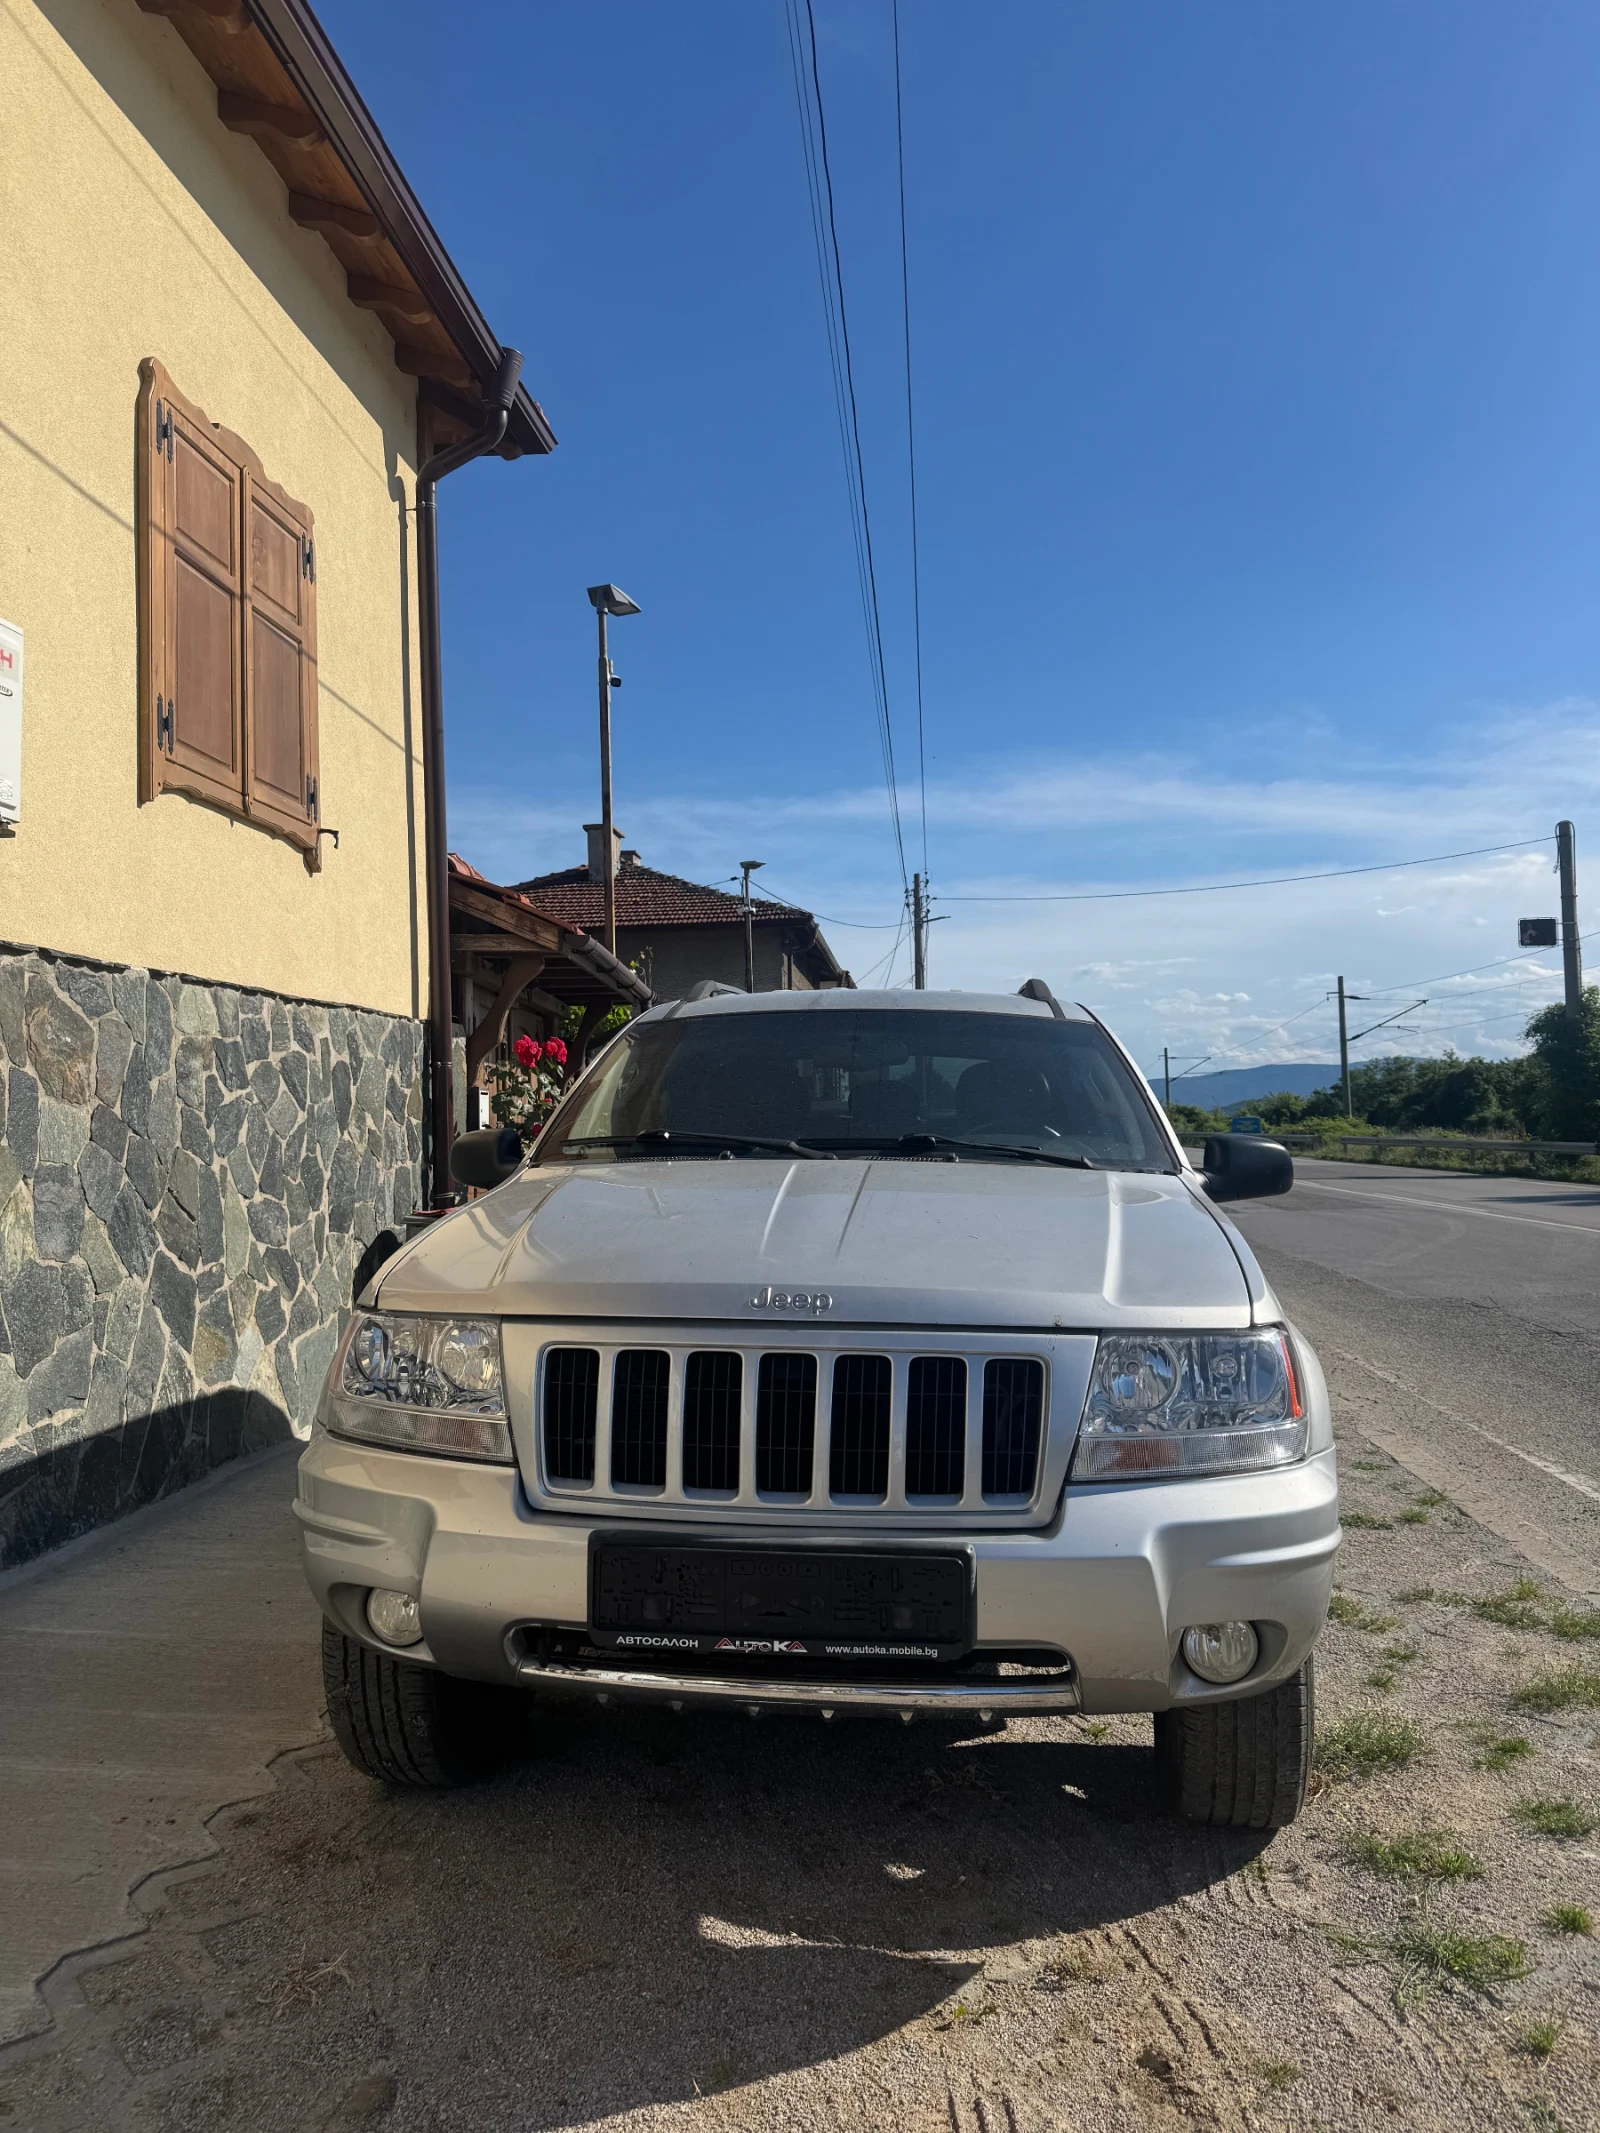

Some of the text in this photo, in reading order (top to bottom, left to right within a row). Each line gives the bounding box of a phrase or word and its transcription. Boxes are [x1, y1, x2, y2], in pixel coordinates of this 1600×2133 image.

[749, 1286, 833, 1316] Jeep
[616, 1635, 699, 1649] АВТОСАЛОН
[825, 1645, 938, 1658] www.autoka.mobile.bg
